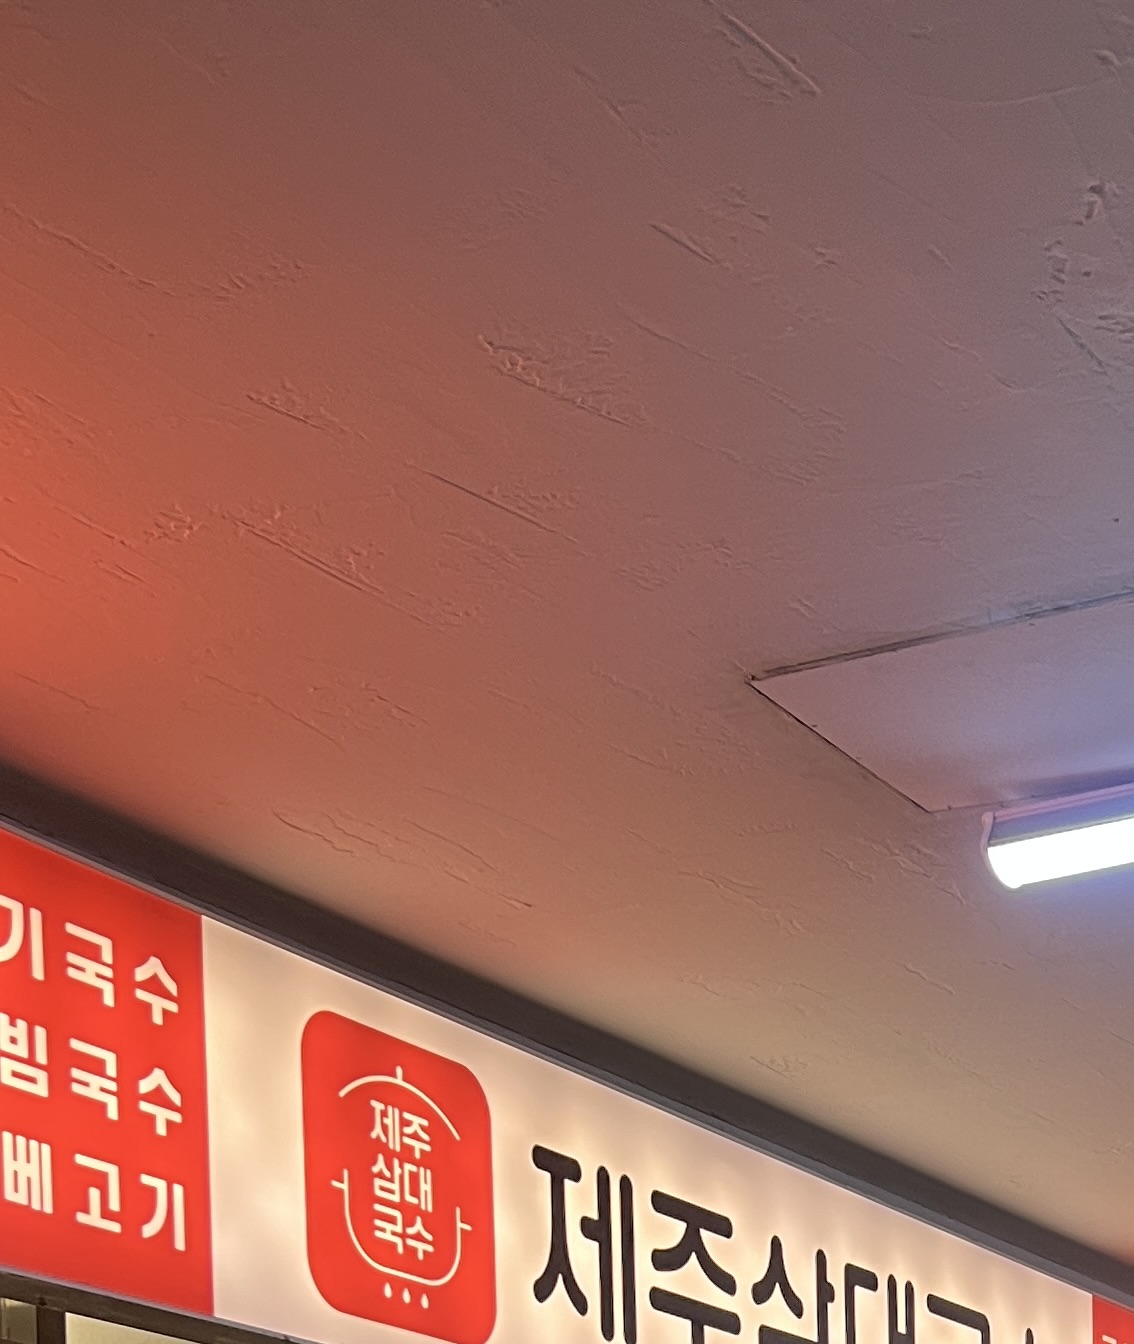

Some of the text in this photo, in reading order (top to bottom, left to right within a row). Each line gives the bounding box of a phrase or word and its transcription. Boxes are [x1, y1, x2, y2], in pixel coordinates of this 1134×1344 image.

[369, 1099, 432, 1160] 제주
[1, 1130, 186, 1252] 베고기
[371, 1153, 433, 1213] 삼대
[372, 1202, 435, 1261] 국수
